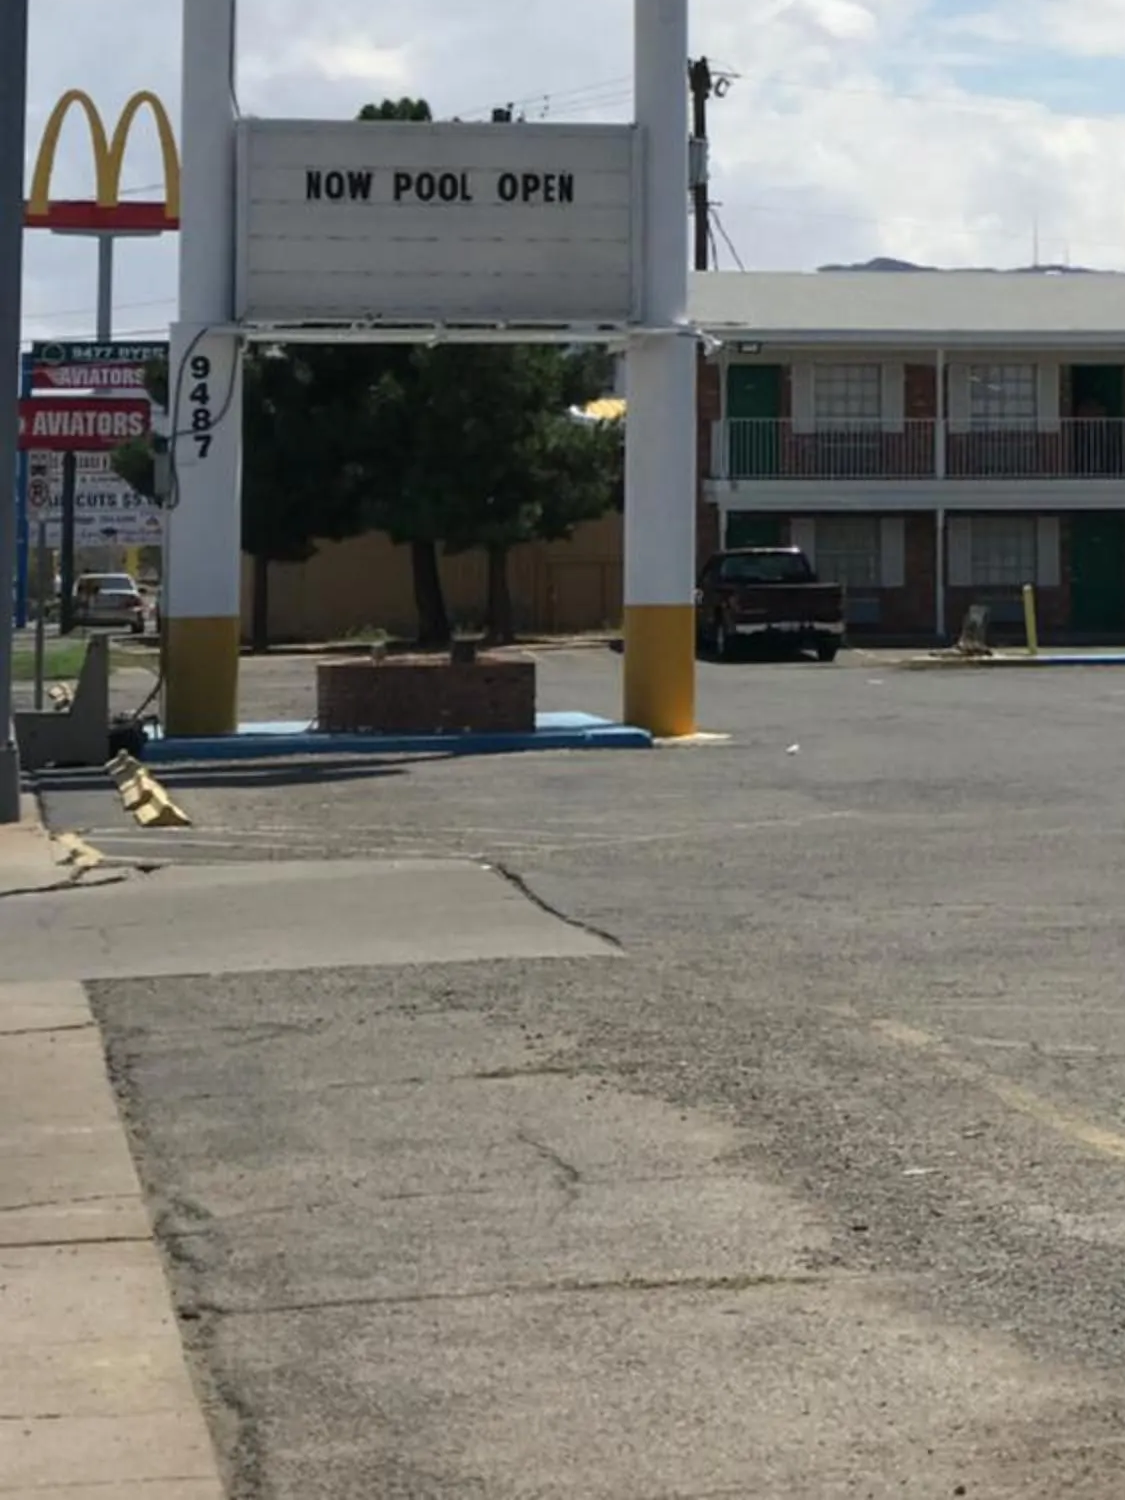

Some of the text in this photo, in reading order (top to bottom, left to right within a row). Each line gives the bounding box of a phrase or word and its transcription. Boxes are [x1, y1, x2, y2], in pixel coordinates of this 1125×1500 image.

[305, 170, 574, 203] NOW POOL OPEN
[58, 367, 145, 385] AVIATORS
[190, 356, 212, 458] 9487
[32, 410, 144, 436] AVIATORS
